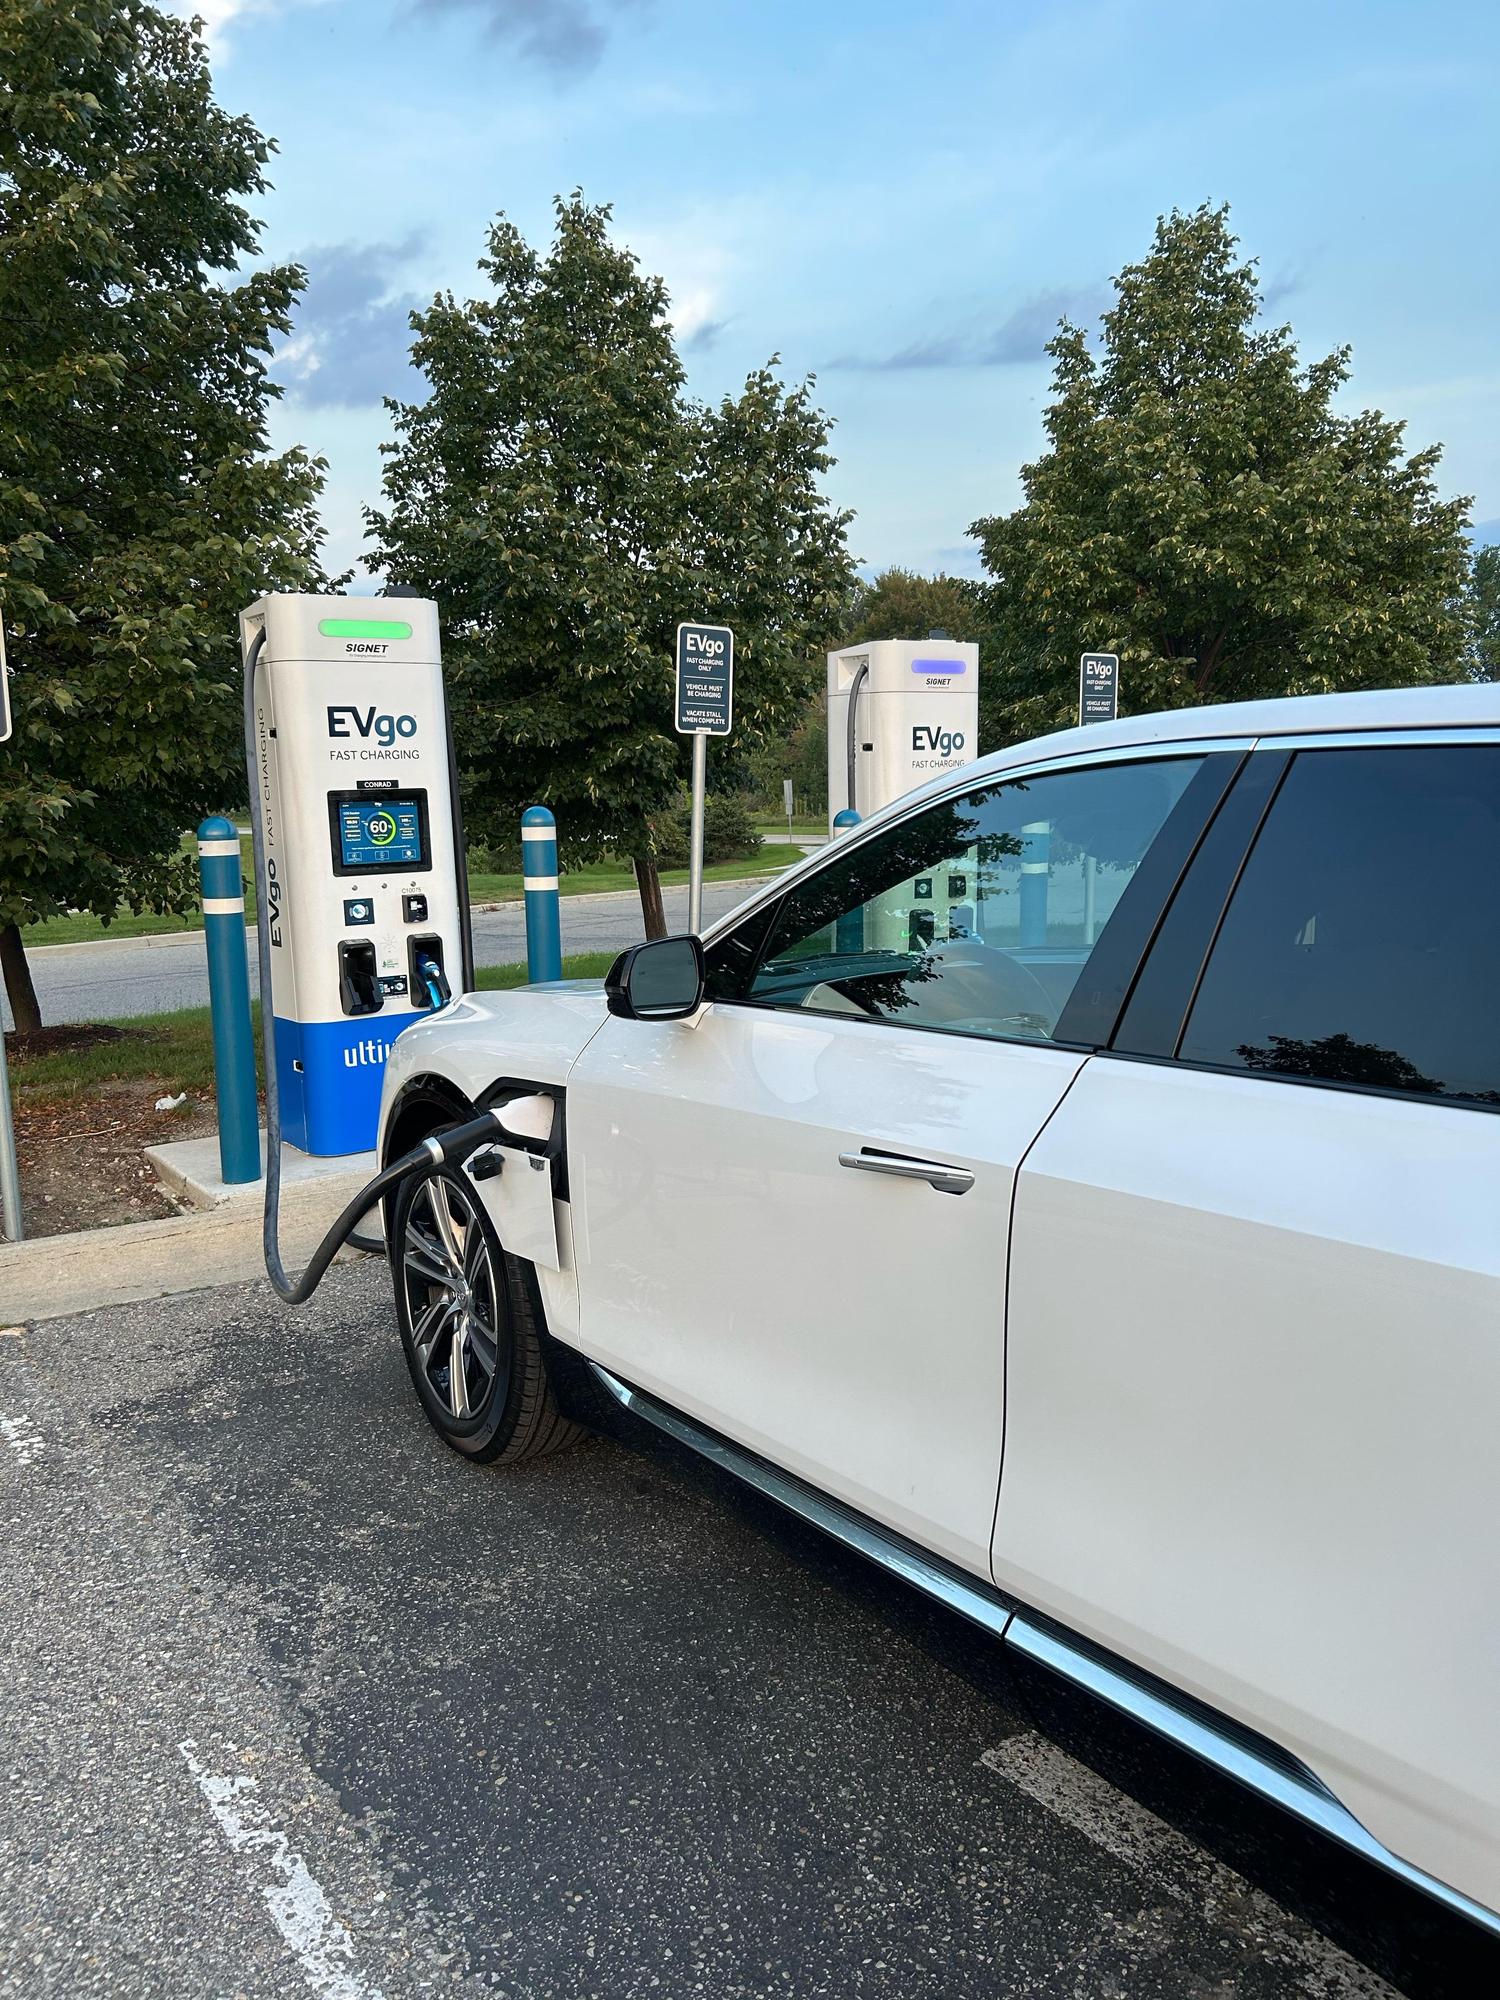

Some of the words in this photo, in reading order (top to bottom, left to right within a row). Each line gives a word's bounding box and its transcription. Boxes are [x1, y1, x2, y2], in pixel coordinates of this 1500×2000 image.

[345, 643, 390, 653] SIGNET
[686, 633, 725, 657] EVgo
[698, 658, 724, 666] CHARGING
[1086, 661, 1113, 679] EVgo
[686, 683, 708, 691] VEHICLE
[694, 691, 722, 699] CHARGING
[686, 709, 706, 717] VACATE
[682, 716, 698, 724] WHEN
[698, 717, 726, 725] COMPLETE
[327, 706, 417, 747] EVgo
[912, 726, 965, 758] EVgo
[258, 708, 271, 801] CHARGING
[330, 750, 358, 760] FAST
[360, 750, 420, 760] CHARGING
[912, 760, 929, 769] FAST
[929, 760, 965, 769] CHARGING
[266, 805, 275, 846] FAST
[268, 858, 283, 948] EVgo
